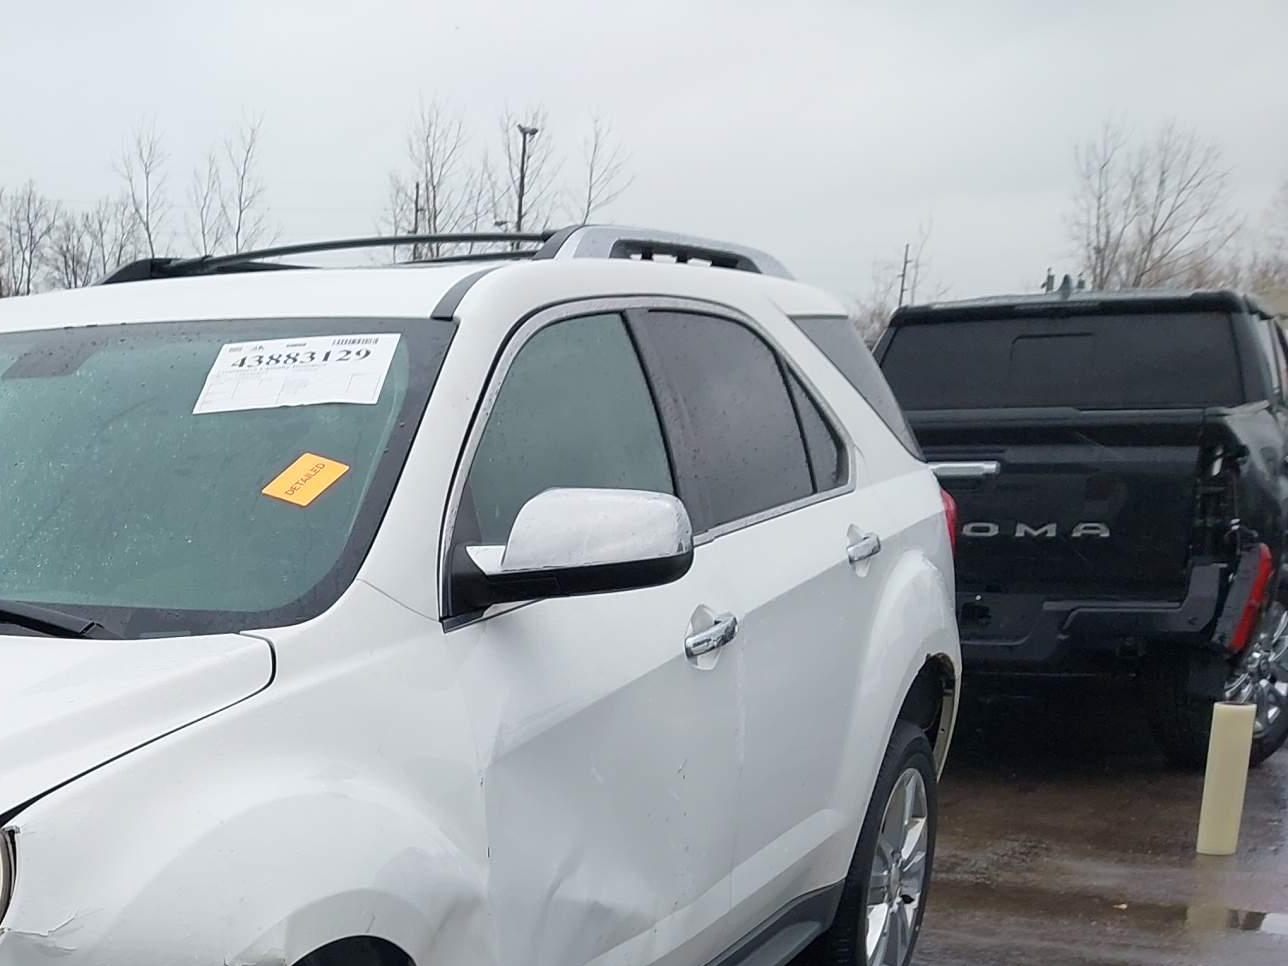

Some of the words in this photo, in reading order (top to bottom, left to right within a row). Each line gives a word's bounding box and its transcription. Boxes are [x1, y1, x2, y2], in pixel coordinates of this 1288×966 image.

[231, 348, 372, 369] 43883129
[284, 462, 327, 497] DETAILED
[961, 522, 1111, 538] OMA
